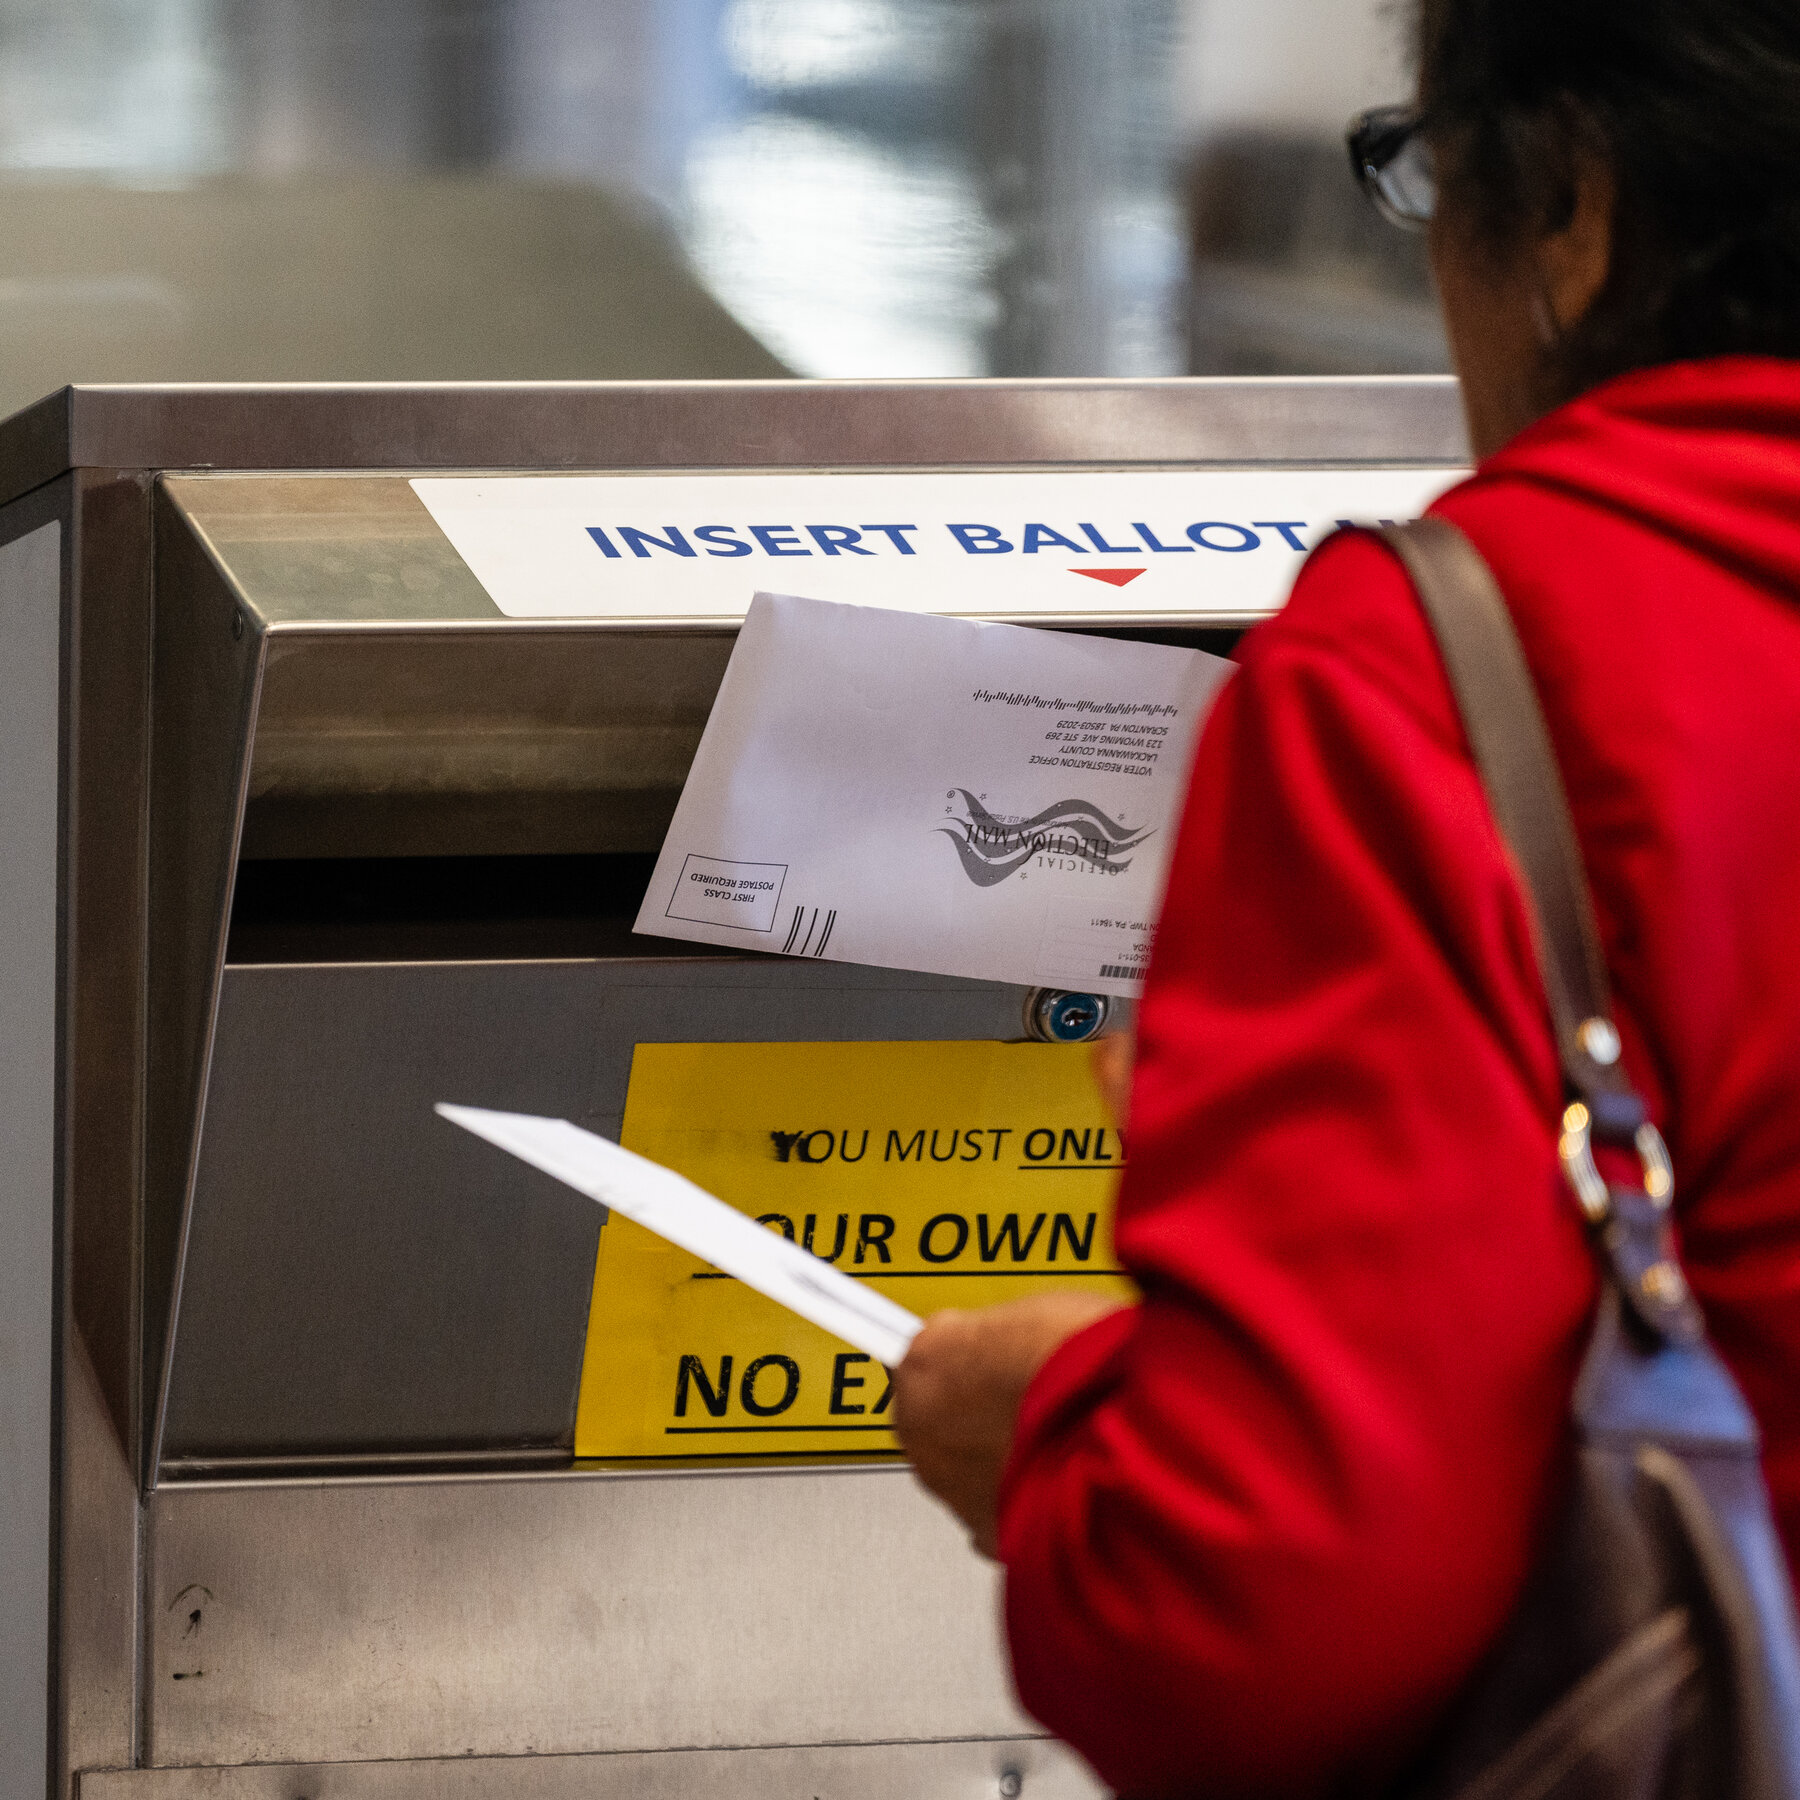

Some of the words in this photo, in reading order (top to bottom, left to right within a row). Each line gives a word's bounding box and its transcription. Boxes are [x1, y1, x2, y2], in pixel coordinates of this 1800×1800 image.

[584, 524, 920, 560] INSERT
[944, 519, 1309, 556] BALLOT
[1056, 720, 1107, 730] 18503-2029
[1122, 725, 1168, 735] SCRANTON
[1063, 733, 1079, 741] STE
[1081, 734, 1099, 742] AVE
[1100, 735, 1144, 746] WYOMING
[1146, 739, 1162, 748] 123
[1059, 745, 1095, 755] COUNTY
[1028, 755, 1059, 765] OFFICE
[1097, 749, 1158, 762] LACKAWANNA
[1060, 758, 1122, 773] REGISTRATION
[1123, 765, 1152, 776] VOTER
[963, 823, 1011, 847] MAIL
[1014, 832, 1110, 859] ELECTION
[1036, 856, 1118, 876] OFFICIAL
[691, 873, 737, 888] REQUIRED
[738, 880, 774, 890] POSTAGE
[703, 889, 731, 899] CLASS
[732, 894, 755, 902] FIRST
[1091, 919, 1112, 928] 18411
[1115, 921, 1126, 929] PA
[769, 1129, 870, 1164] YOU
[884, 1129, 1013, 1162] MUST
[918, 1212, 1098, 1263] OWN
[672, 1354, 801, 1418] NO
